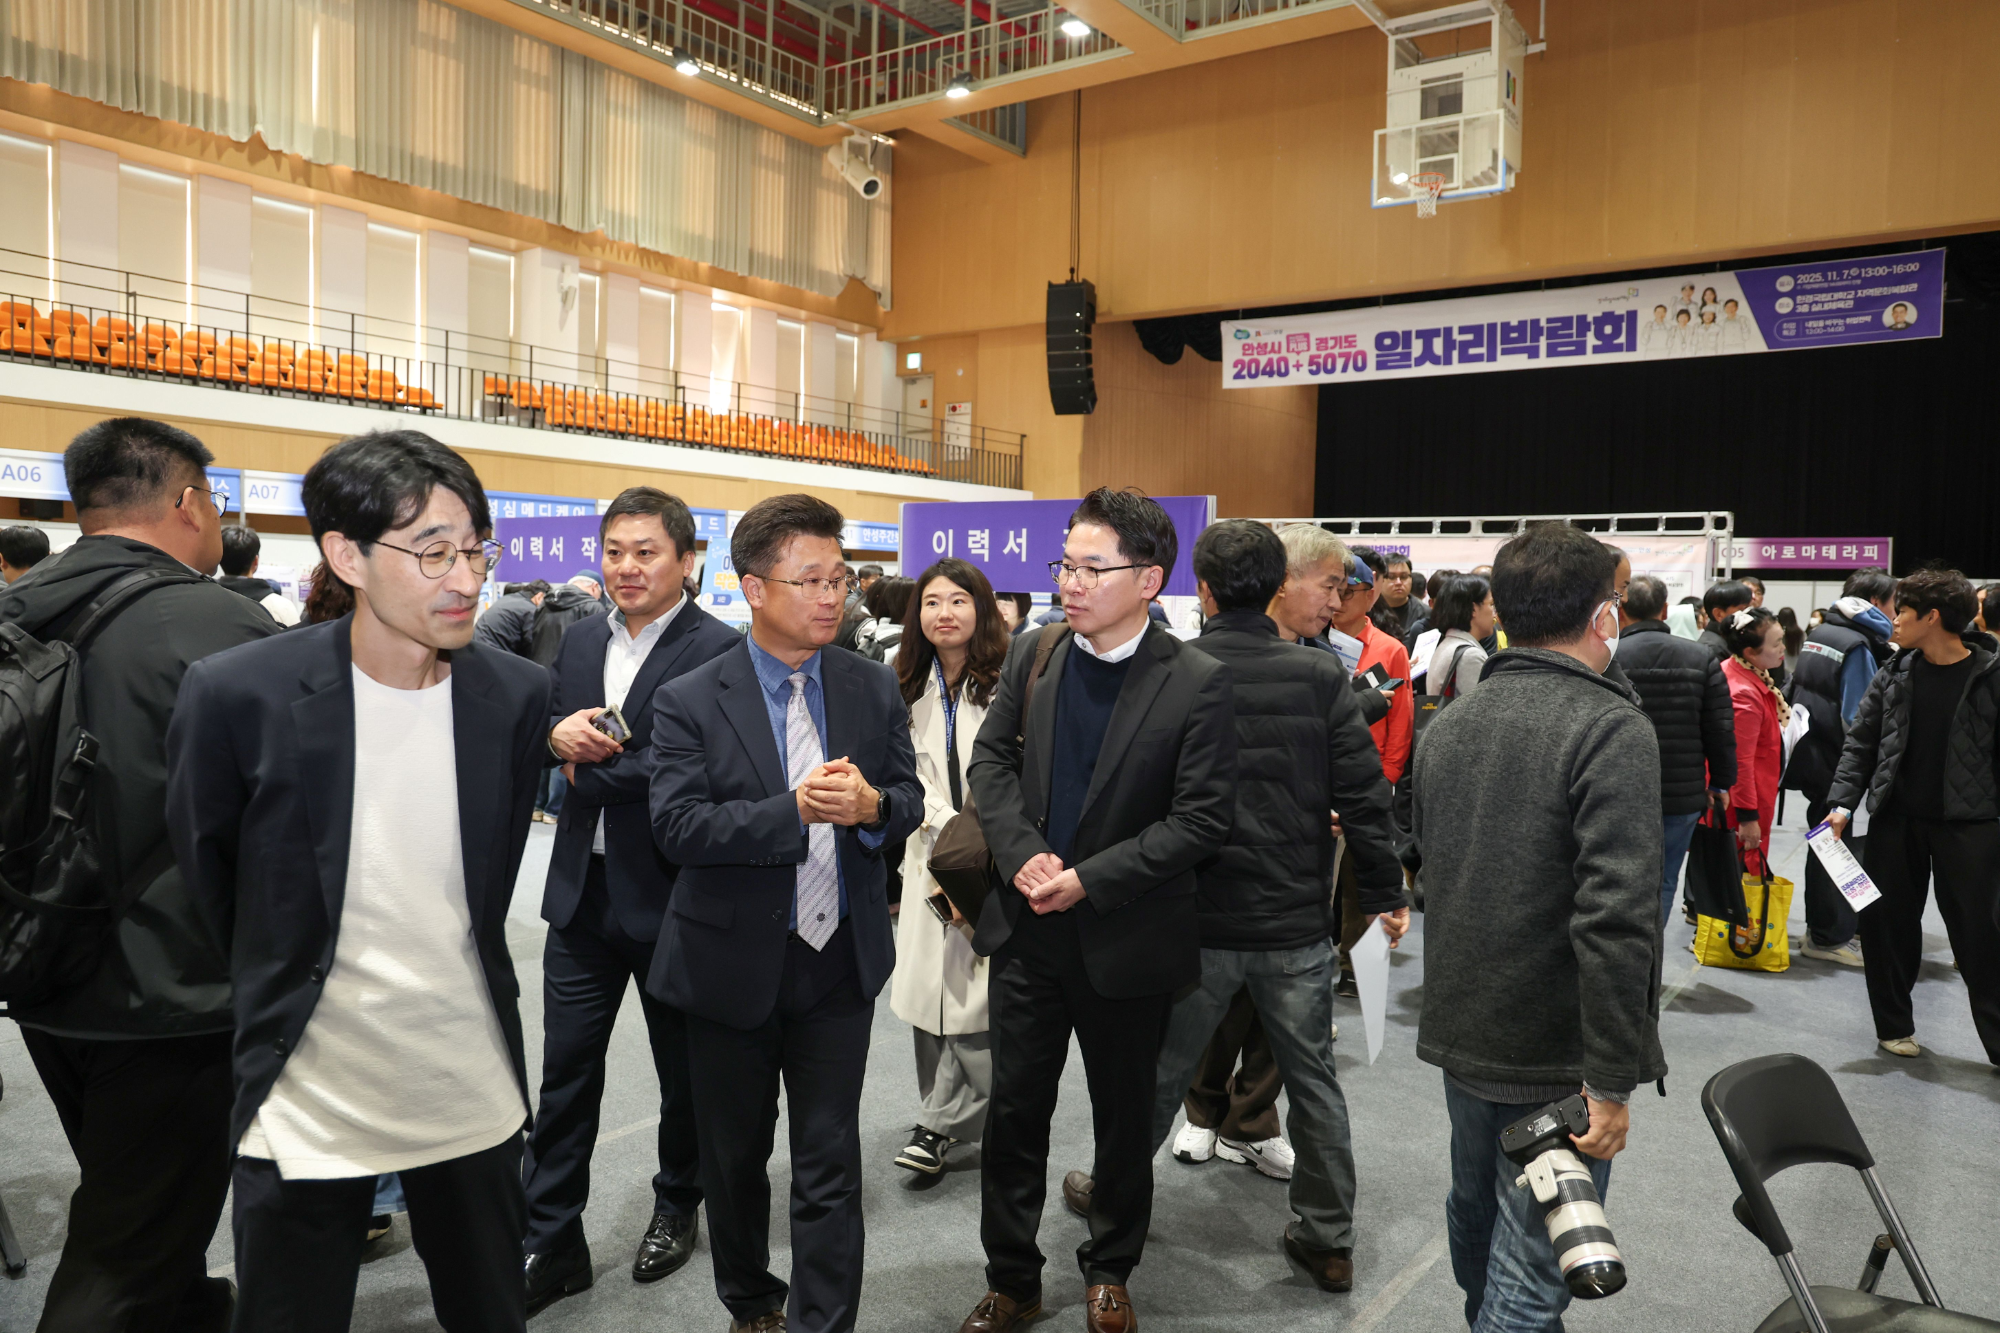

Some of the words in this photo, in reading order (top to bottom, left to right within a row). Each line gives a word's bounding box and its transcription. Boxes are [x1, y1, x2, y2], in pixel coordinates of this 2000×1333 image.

[1242, 340, 1282, 356] 안성시
[1315, 334, 1358, 351] 경기도
[1374, 309, 1639, 371] 일자리박람회
[1, 464, 42, 483] A06
[248, 484, 280, 500] A07
[510, 536, 564, 562] 이력서
[932, 528, 1028, 562] 이력서
[1761, 544, 1880, 561] 아로마테라피
